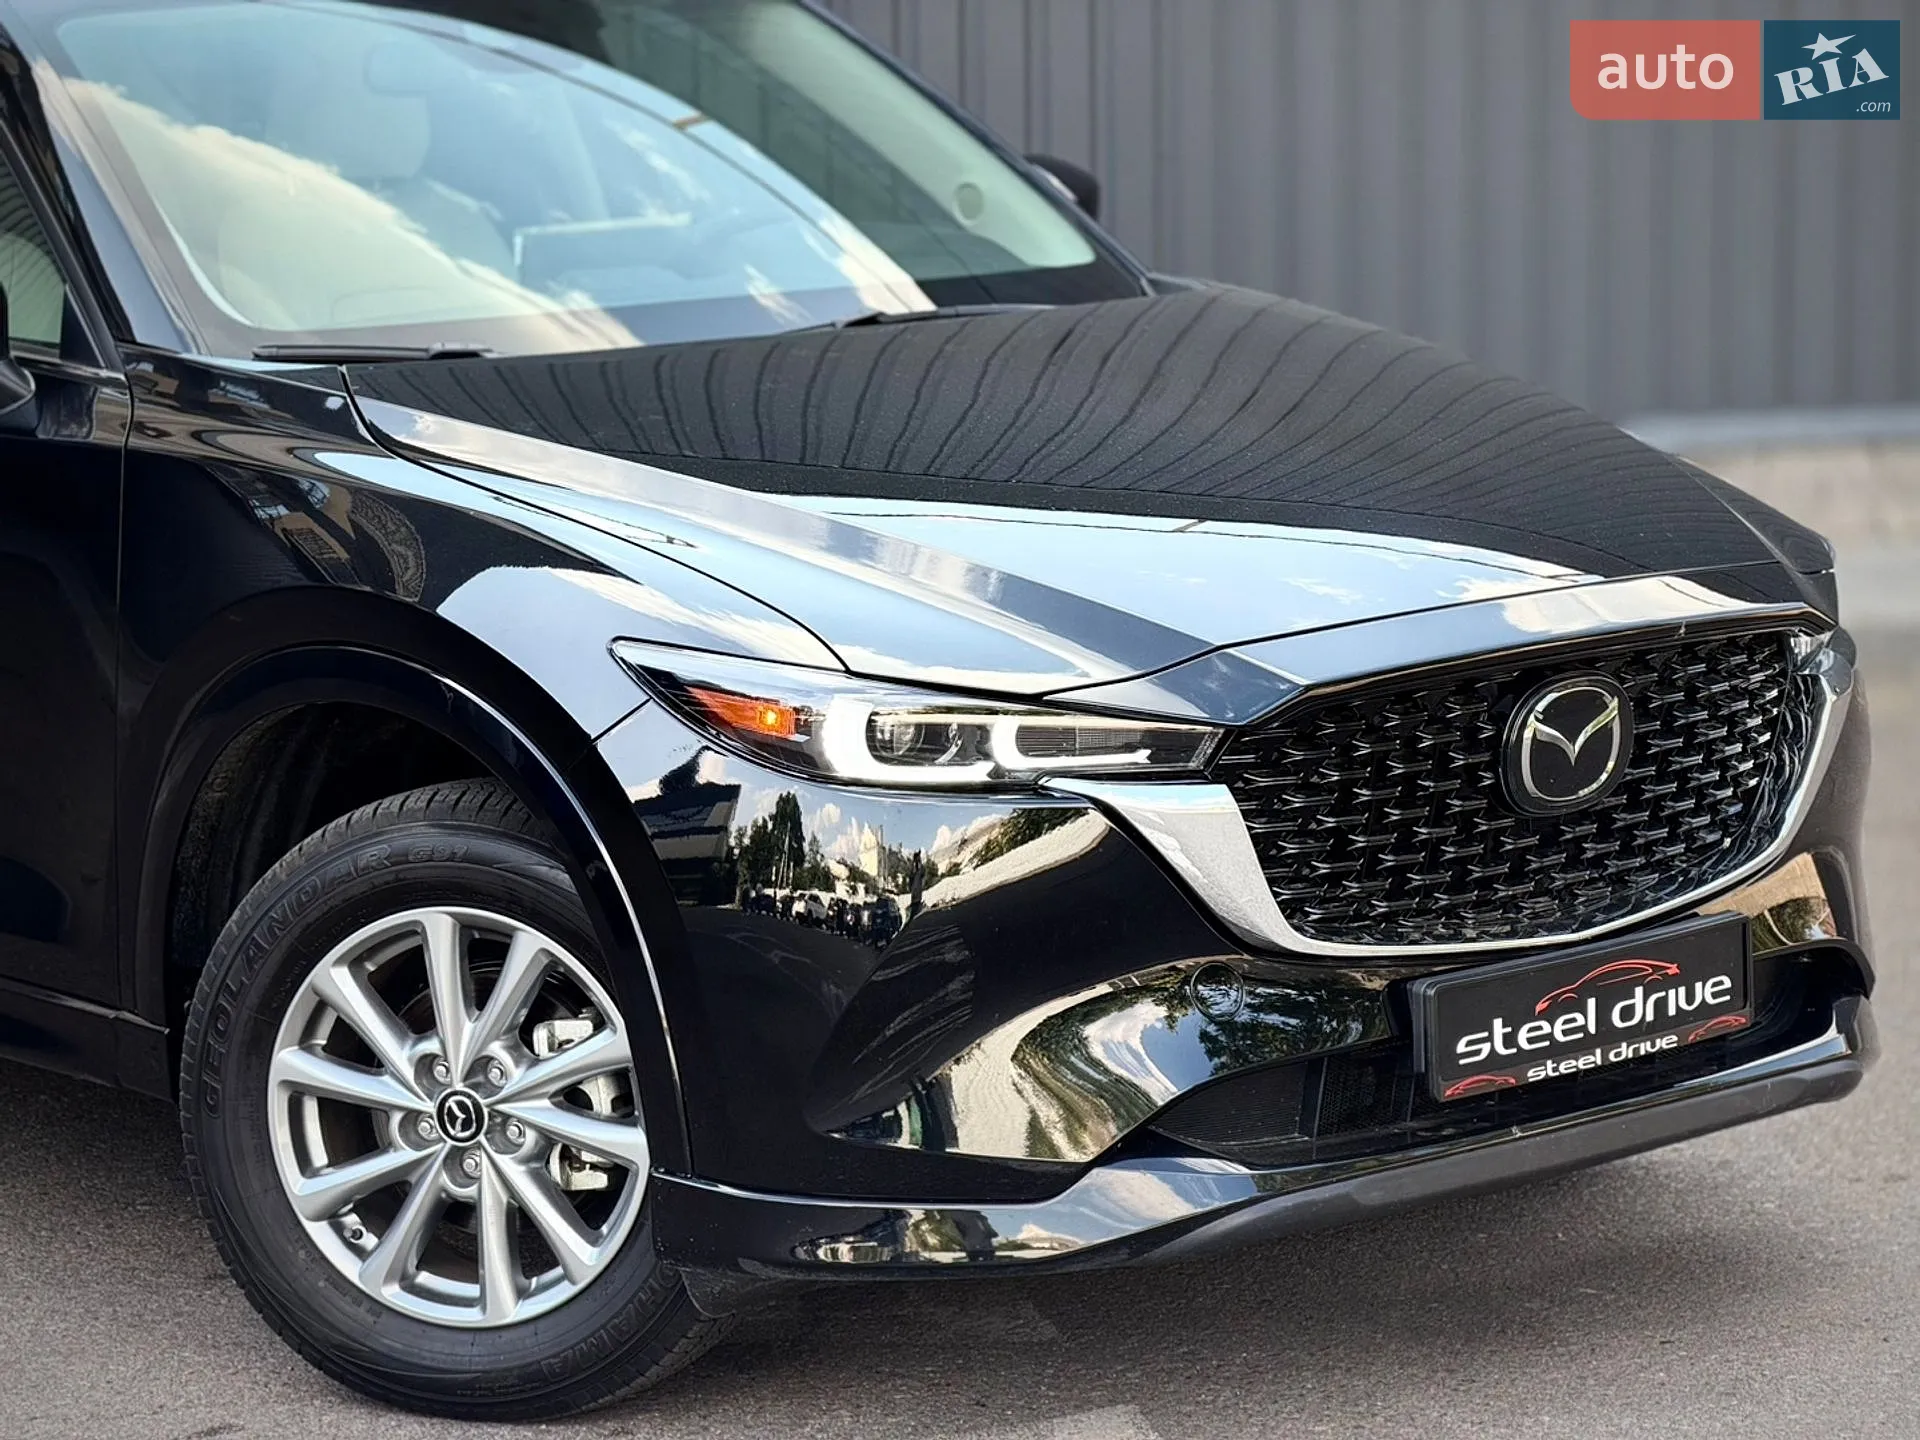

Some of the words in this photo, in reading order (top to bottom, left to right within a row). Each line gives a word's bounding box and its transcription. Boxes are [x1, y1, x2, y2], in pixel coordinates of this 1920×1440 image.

[203, 844, 392, 1118] GEOLANDAR
[1456, 998, 1597, 1065] steel
[1612, 975, 1732, 1028] drive
[1527, 1049, 1602, 1082] steel
[1609, 1034, 1679, 1062] drive
